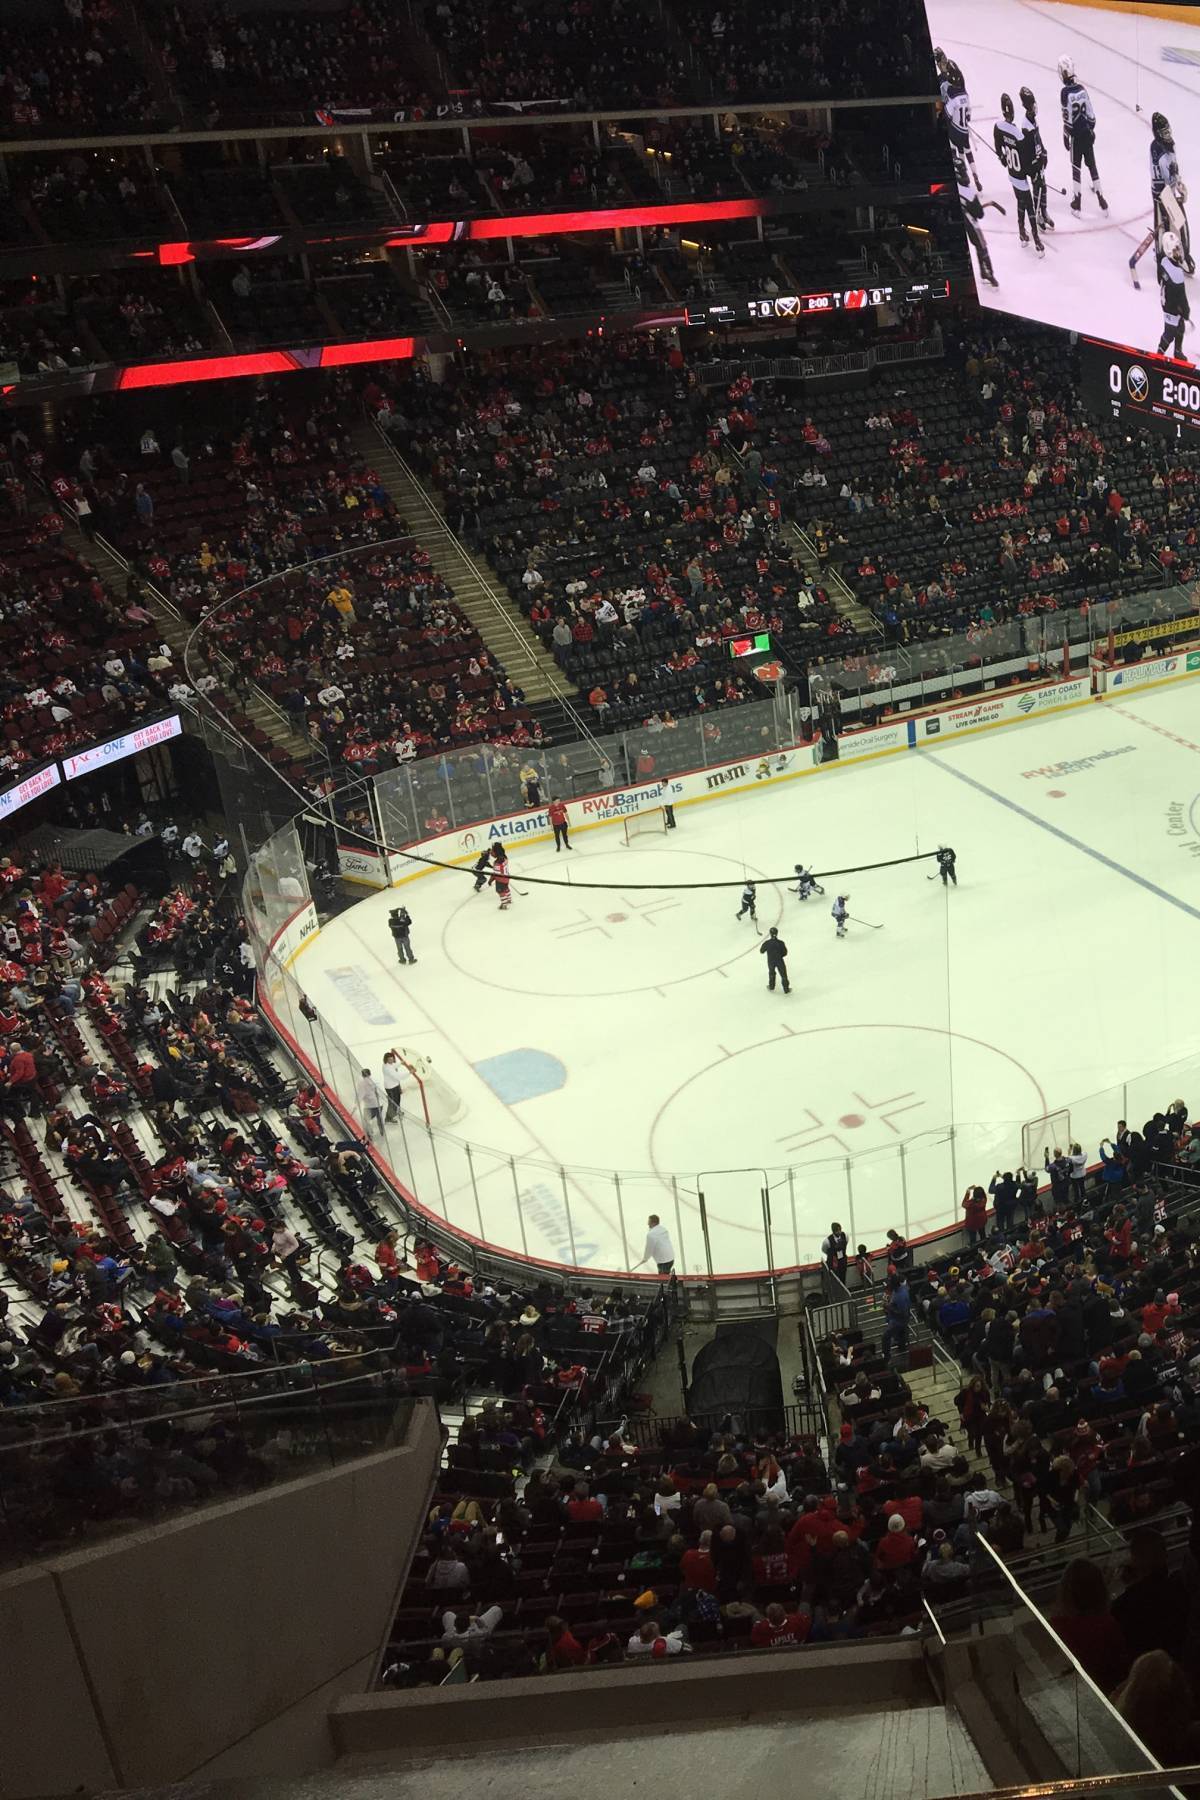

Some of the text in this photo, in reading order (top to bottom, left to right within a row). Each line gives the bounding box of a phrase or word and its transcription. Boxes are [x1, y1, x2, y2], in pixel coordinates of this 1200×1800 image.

[761, 302, 770, 315] 0
[808, 298, 828, 308] 2:00
[1110, 364, 1122, 393] 0
[1162, 378, 1200, 411] 2:00
[1176, 424, 1182, 438] 1
[1038, 682, 1082, 698] EAST COAST
[983, 703, 1004, 713] GAMES
[969, 718, 978, 726] ON
[1165, 801, 1188, 836] Center
[345, 857, 368, 872] Ford
[300, 918, 316, 940] NHL
